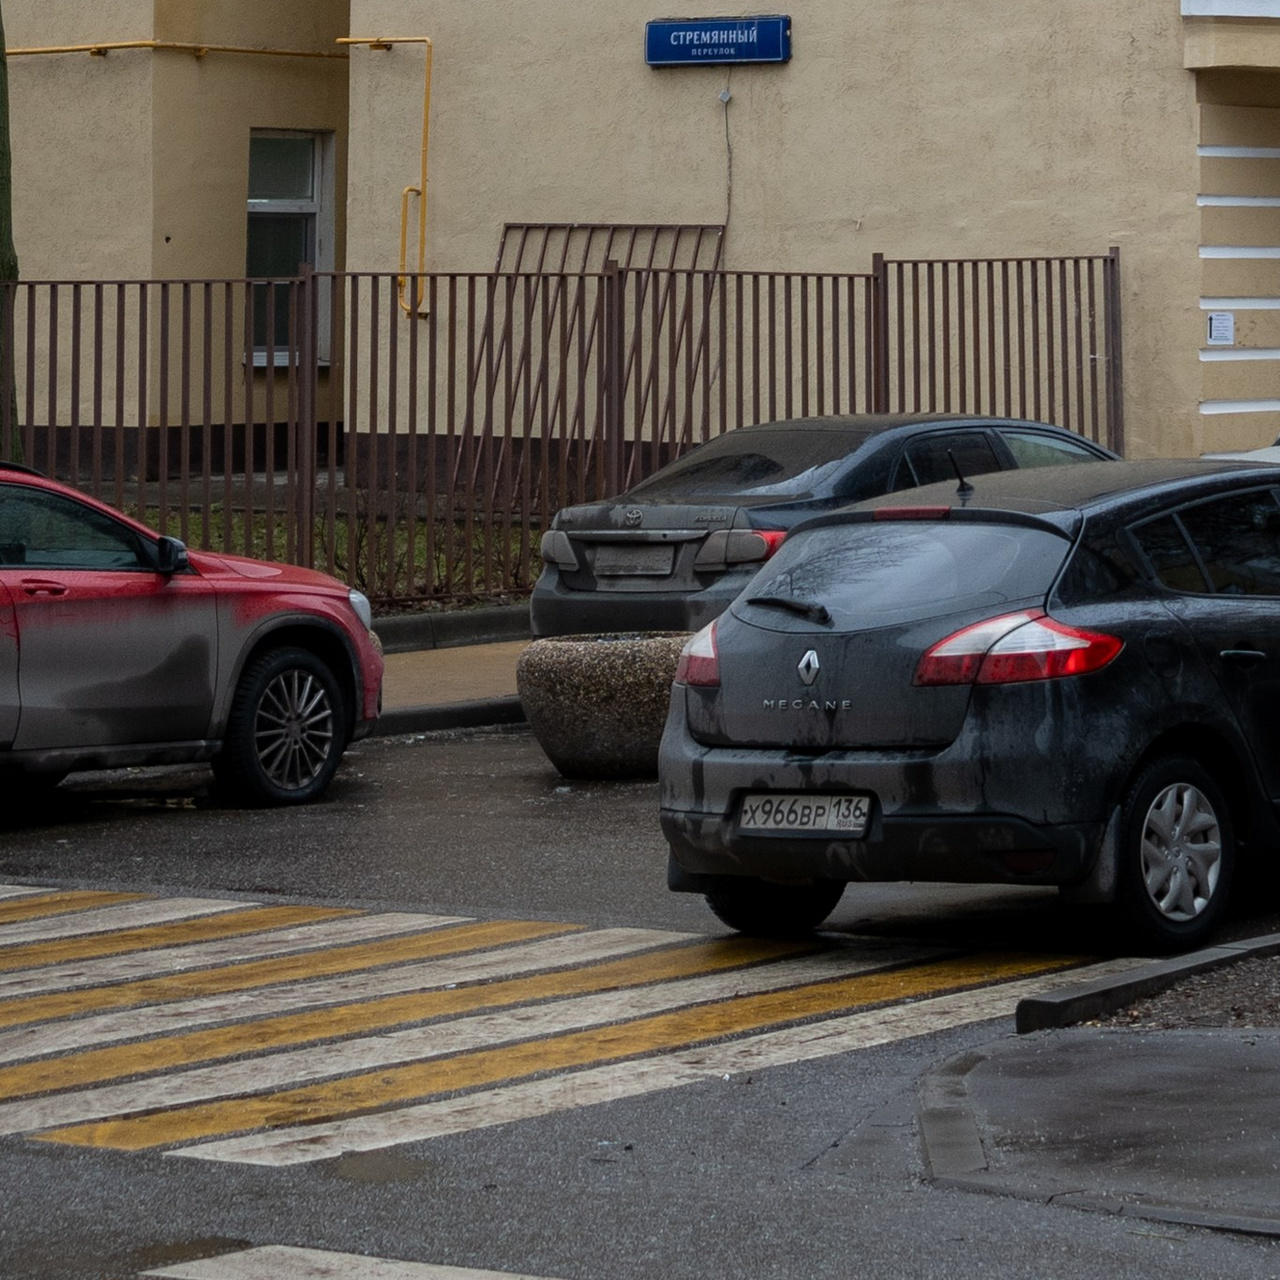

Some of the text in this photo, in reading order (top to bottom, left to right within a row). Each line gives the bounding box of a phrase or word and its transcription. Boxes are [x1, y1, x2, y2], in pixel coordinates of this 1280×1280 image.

[670, 26, 758, 45] СТРЕМЯННЫЙ
[691, 47, 736, 56] ПЕРЕУЛОК
[763, 699, 852, 710] MEGANE
[832, 798, 863, 819] 136
[836, 820, 852, 828] RUS
